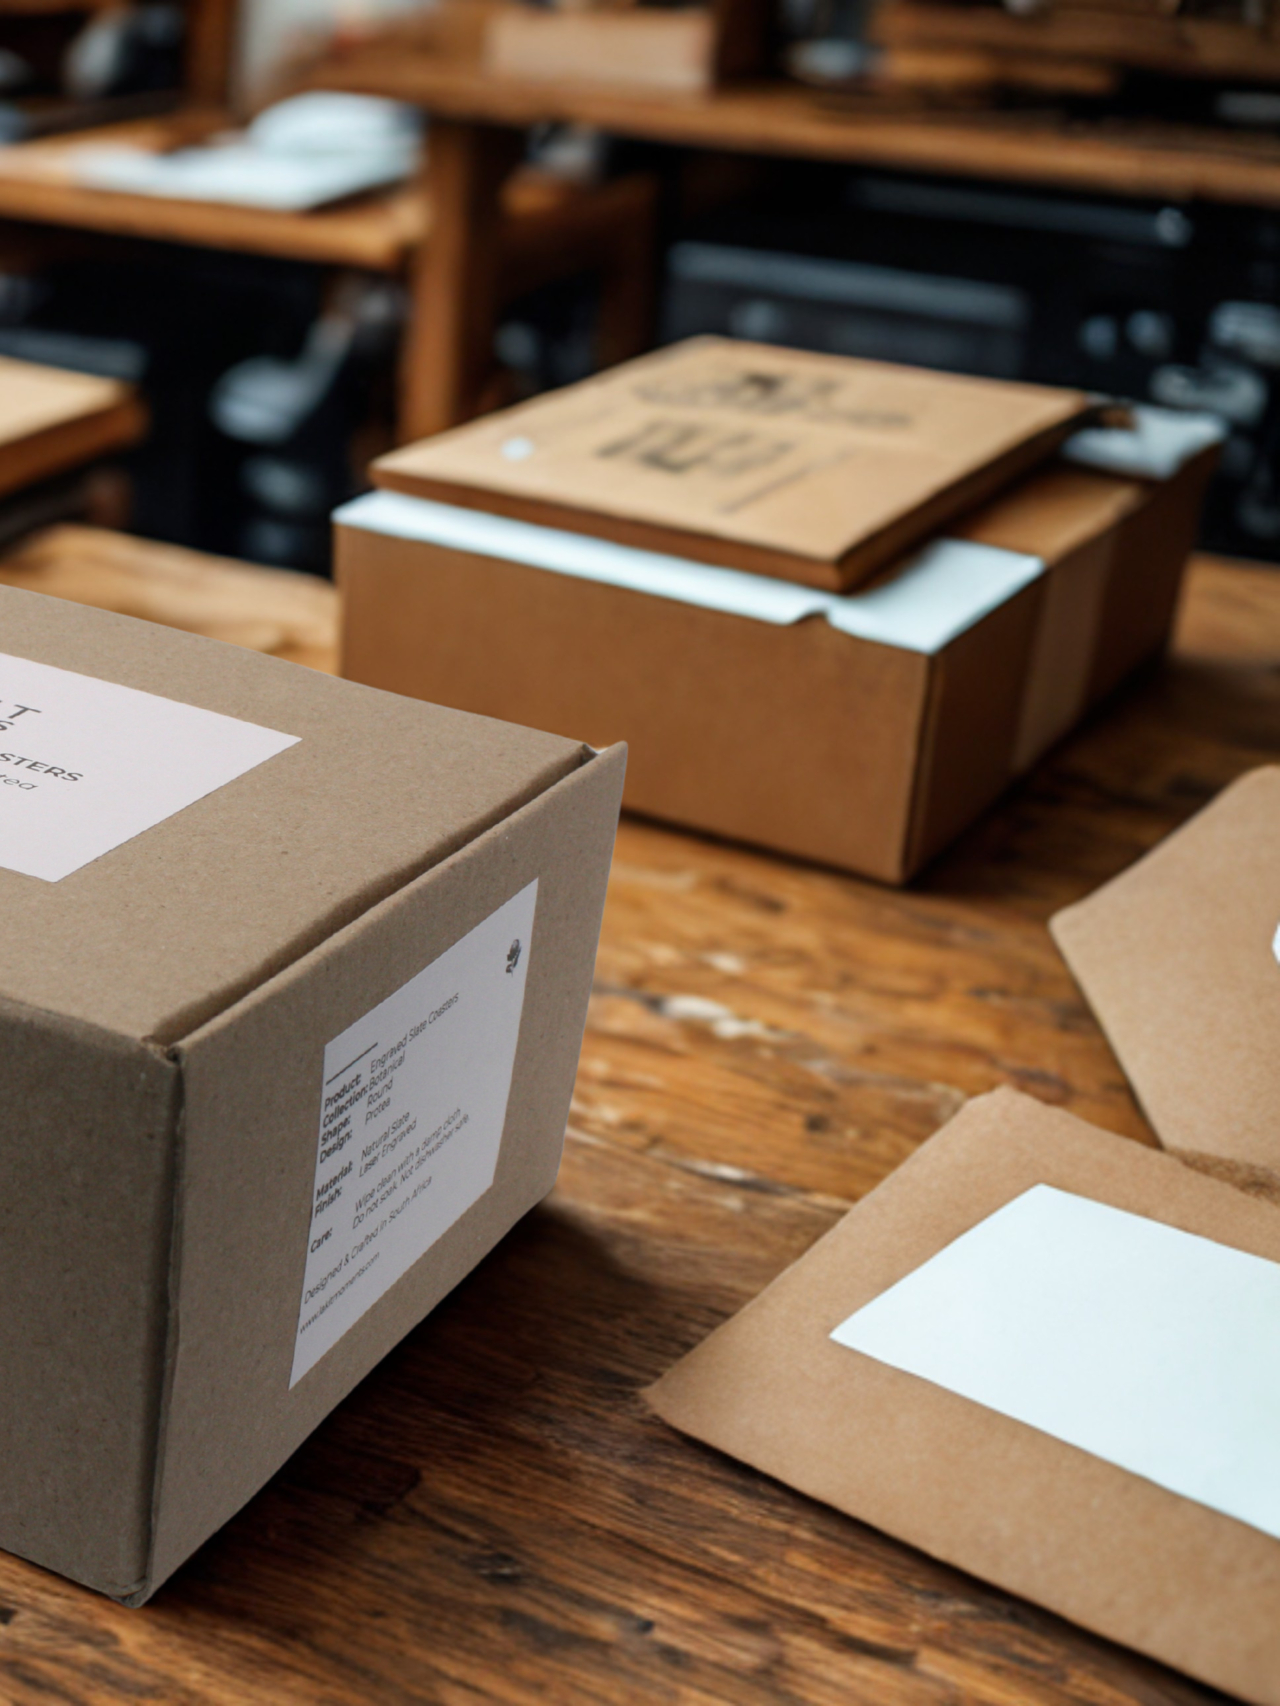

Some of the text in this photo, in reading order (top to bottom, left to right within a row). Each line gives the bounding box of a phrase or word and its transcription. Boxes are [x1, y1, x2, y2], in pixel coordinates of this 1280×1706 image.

[323, 1050, 406, 1128] Collection: Botanical
[324, 992, 459, 1112] Product: Engraved Slate Coasters
[316, 1111, 410, 1201] Material: Natural Slate
[320, 1097, 391, 1164] Design: Protea
[321, 1076, 393, 1147] Shape: Round
[310, 1227, 333, 1254] Care:
[355, 1188, 376, 1212] Wipe
[397, 1151, 414, 1173] with
[421, 1126, 442, 1151] damp
[314, 1116, 417, 1218] Finish: Laser Engraved
[352, 1213, 365, 1230] Do
[365, 1198, 380, 1218] not
[400, 1165, 414, 1185] Not
[304, 1258, 343, 1305] Designed
[343, 1253, 350, 1267] &
[351, 1224, 379, 1260] Crafted
[379, 1219, 387, 1233] in
[388, 1195, 411, 1224] South
